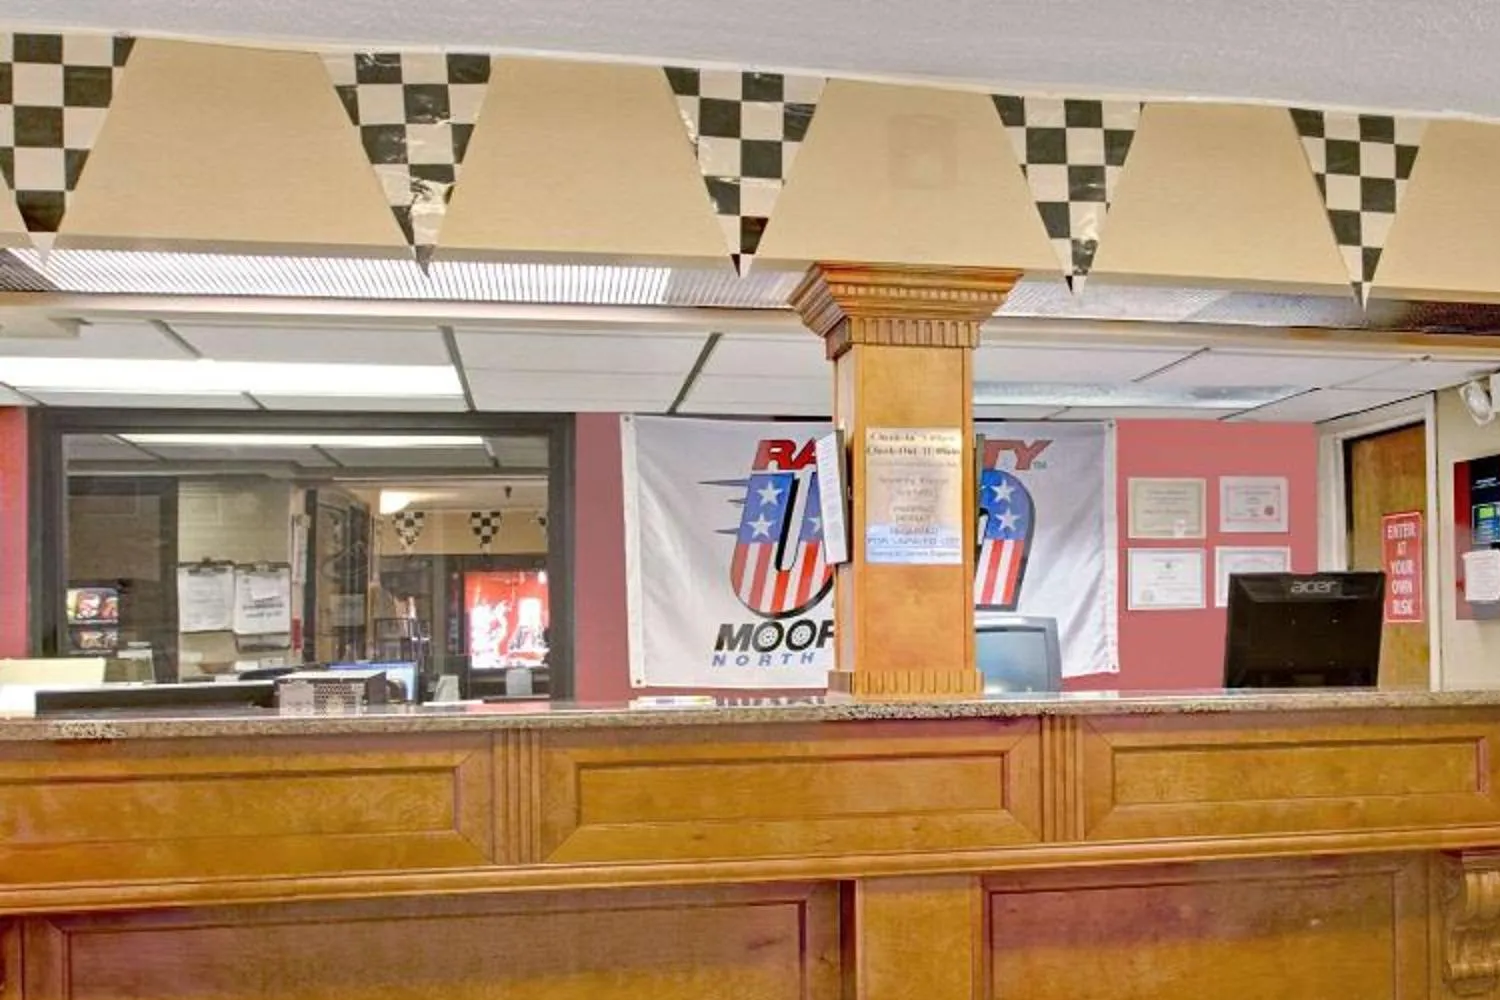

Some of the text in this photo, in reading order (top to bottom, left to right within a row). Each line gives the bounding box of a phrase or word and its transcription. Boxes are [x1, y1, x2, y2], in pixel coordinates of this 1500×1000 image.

[751, 438, 818, 470] RA
[983, 439, 1054, 471] TY
[1387, 523, 1416, 539] ENTER
[1391, 559, 1413, 575] YOUR
[1291, 581, 1337, 593] acer
[1391, 579, 1413, 595] OWN
[1392, 599, 1413, 615] RISK
[712, 652, 815, 667] NORTH
